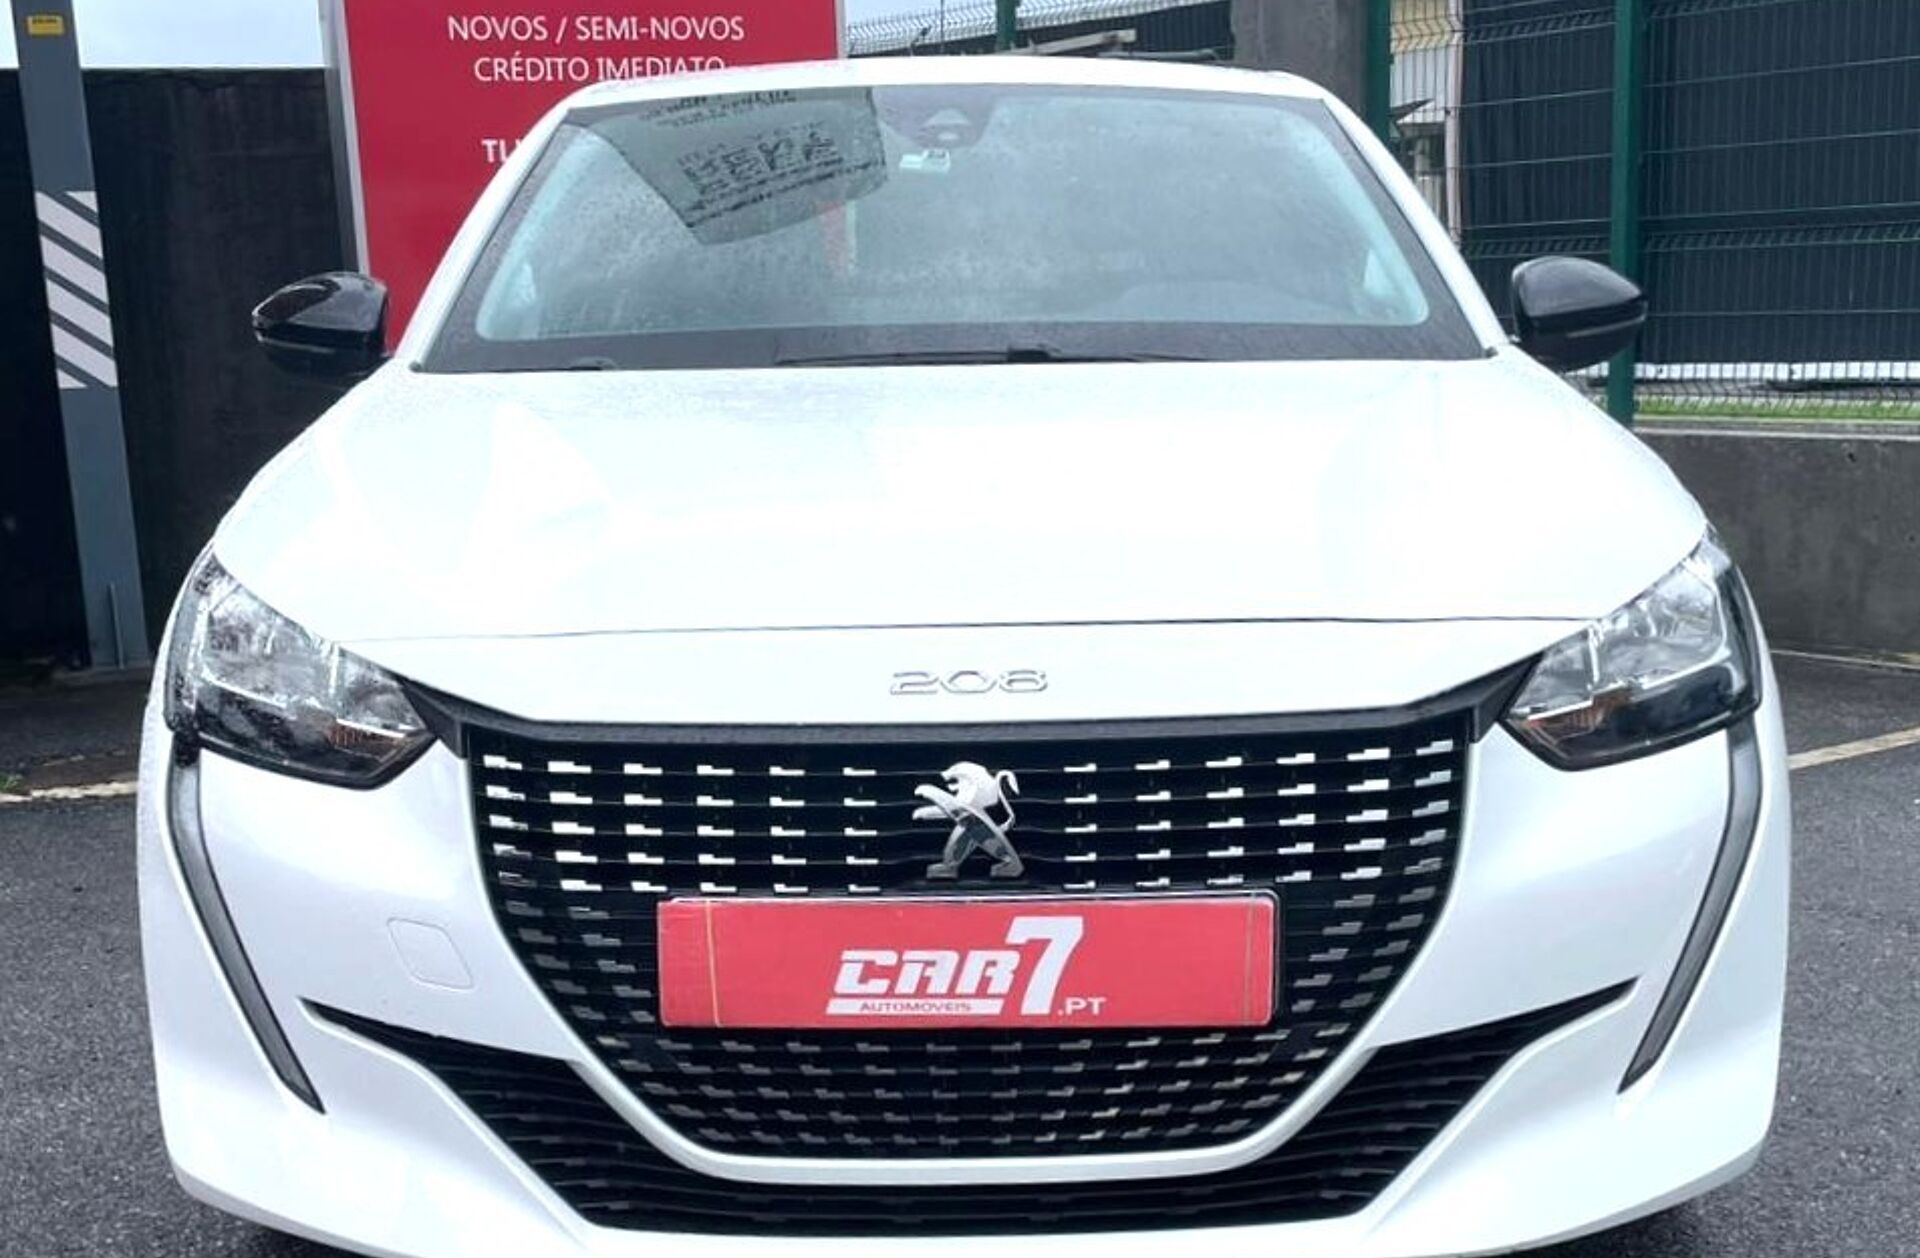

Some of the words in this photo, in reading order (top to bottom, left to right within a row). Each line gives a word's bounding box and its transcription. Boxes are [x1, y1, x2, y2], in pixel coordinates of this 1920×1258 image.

[447, 15, 549, 41] NOVOS
[554, 16, 568, 45] /
[575, 14, 745, 41] SEMI-NOVOS
[473, 51, 590, 82] CRÉDITO
[889, 669, 1049, 696] 208
